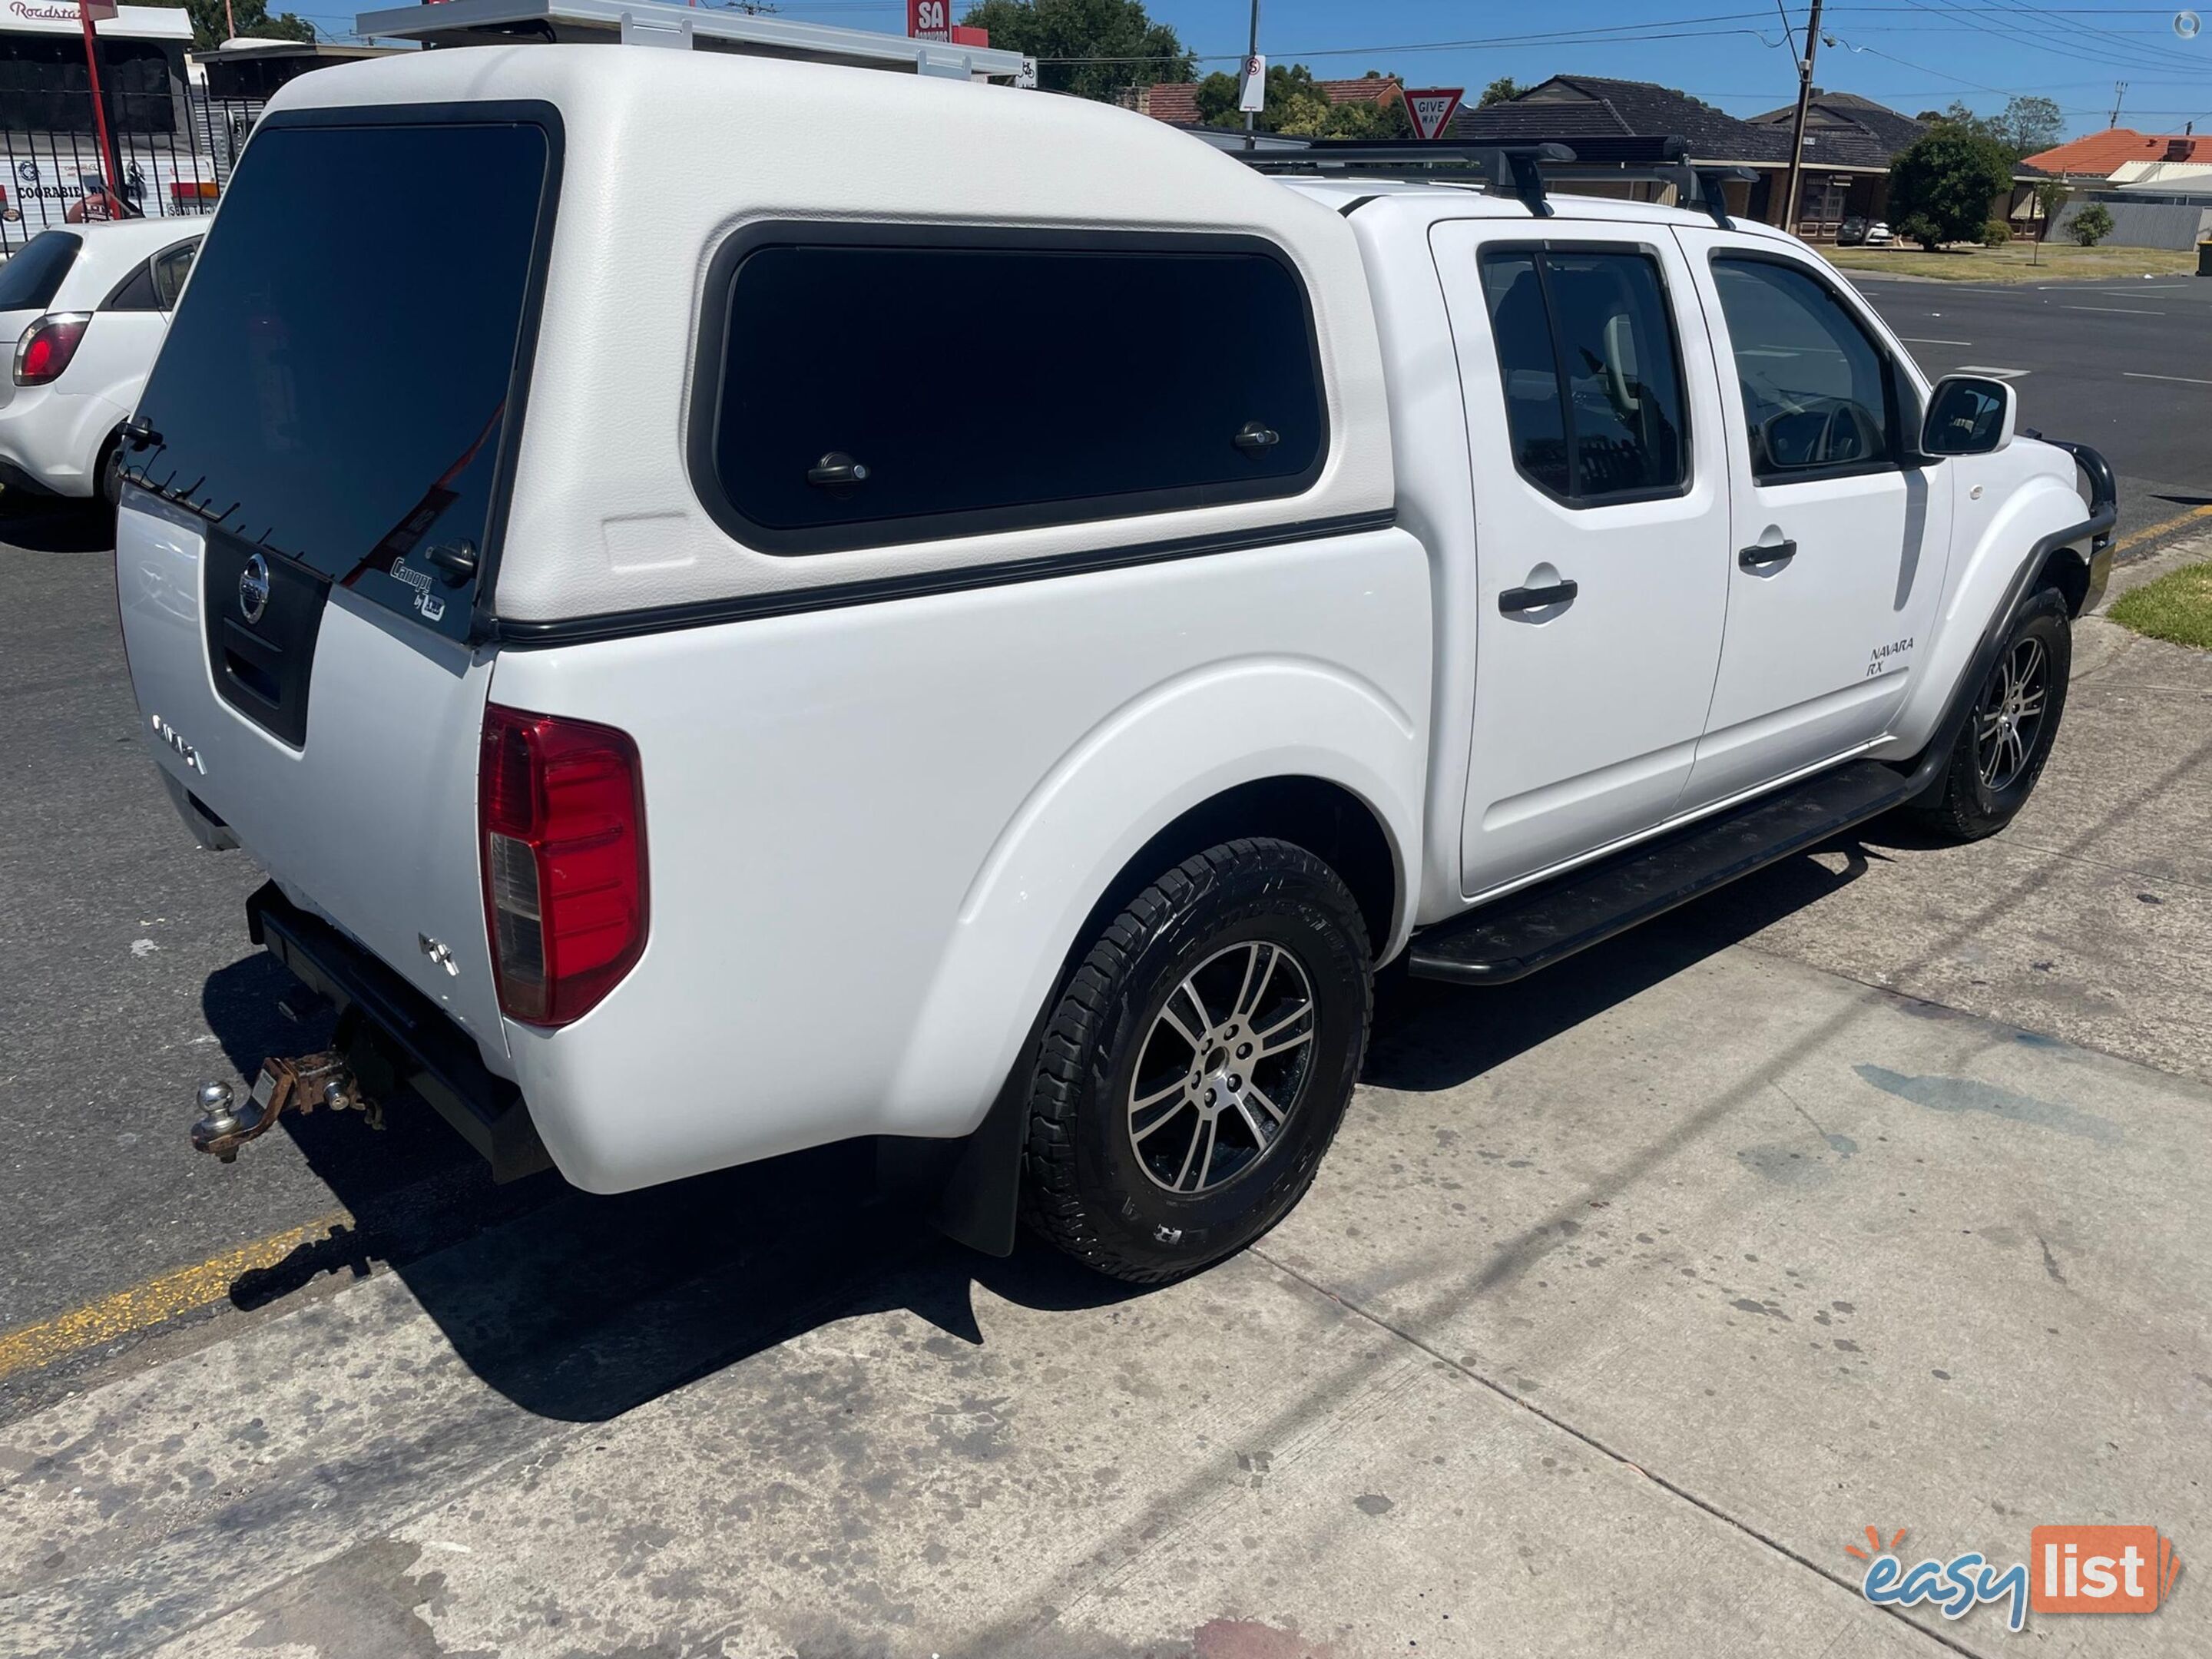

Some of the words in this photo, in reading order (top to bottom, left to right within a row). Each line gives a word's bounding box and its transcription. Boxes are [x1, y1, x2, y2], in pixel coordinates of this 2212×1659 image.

[918, 1, 944, 29] SA
[1419, 101, 1445, 113] GIVE
[1422, 115, 1440, 124] WAY
[390, 556, 432, 594] Canopy
[1869, 637, 1914, 661] NAVARA
[1866, 661, 1884, 677] RX
